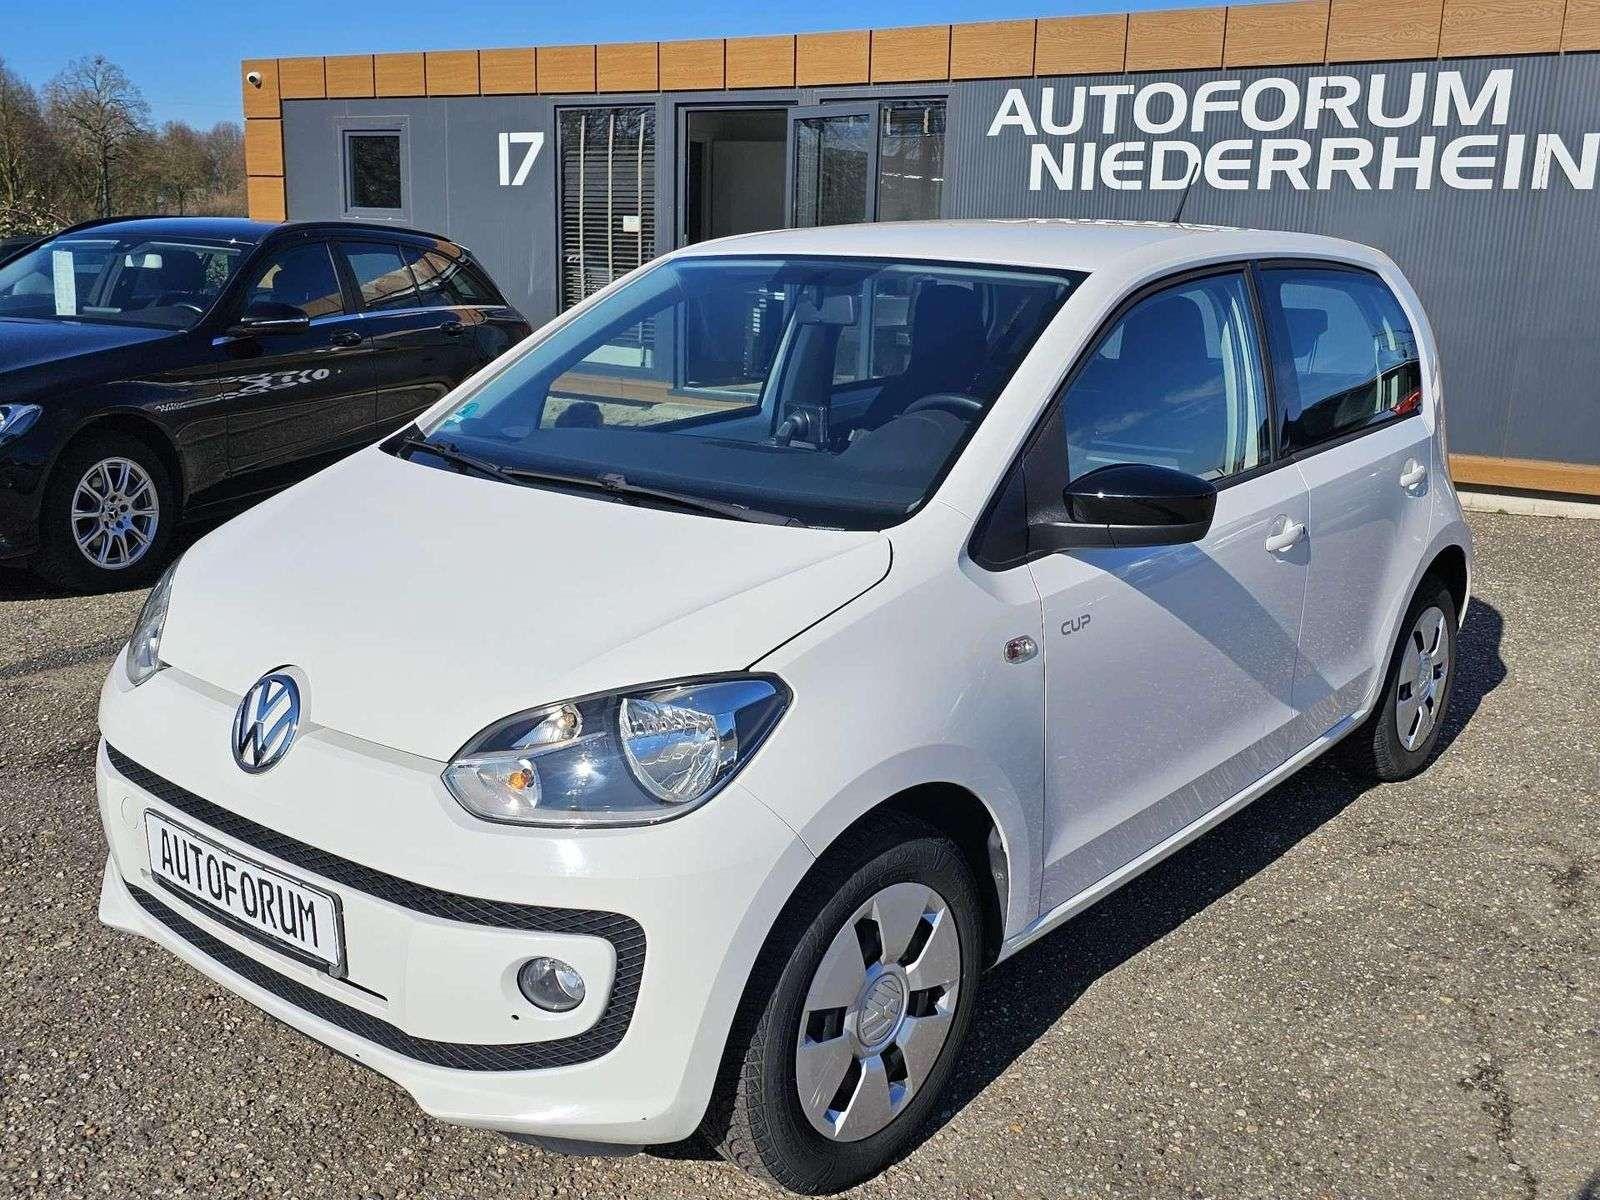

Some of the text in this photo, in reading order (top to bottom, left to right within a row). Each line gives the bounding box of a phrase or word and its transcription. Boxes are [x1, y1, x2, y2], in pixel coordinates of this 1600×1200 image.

[986, 69, 1514, 136] AUTOFORUM
[498, 131, 544, 186] 17
[1029, 132, 1600, 191] NIEDERRHEIN
[1061, 614, 1091, 636] CUP
[161, 827, 319, 949] AUTOFORUM
